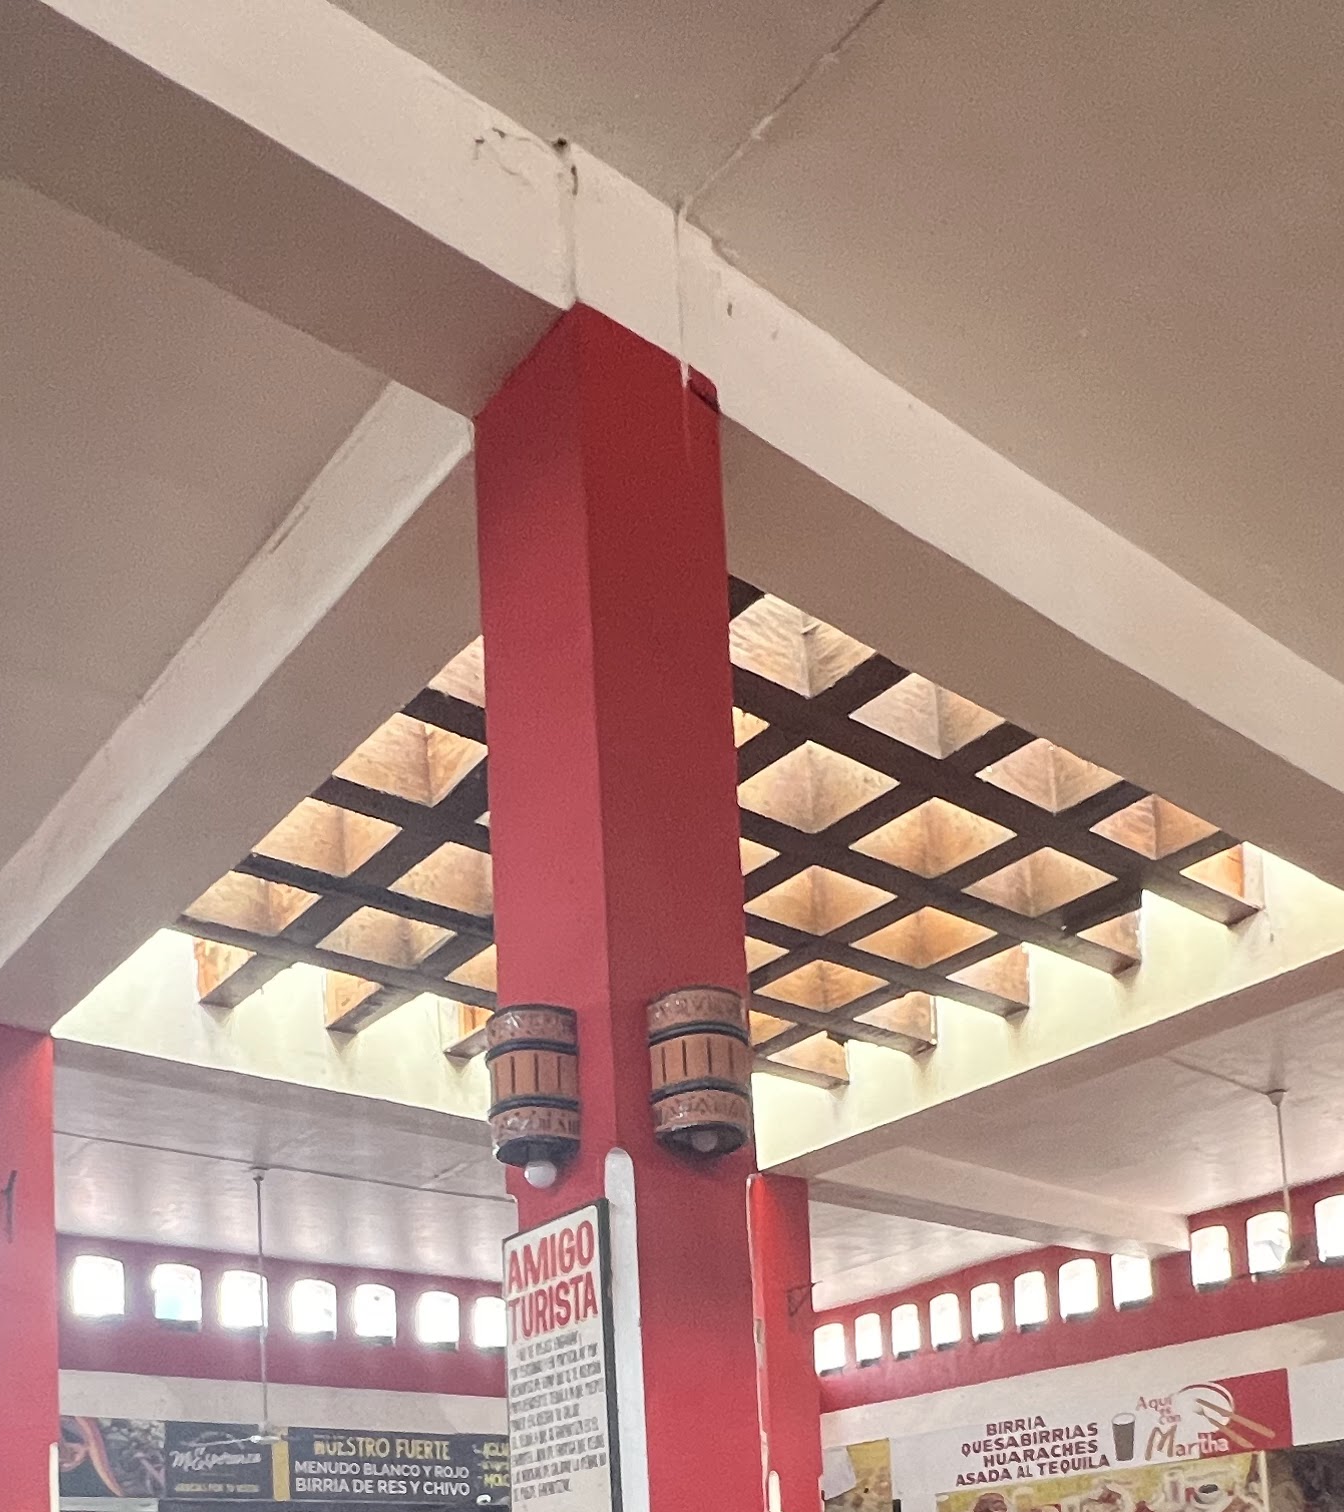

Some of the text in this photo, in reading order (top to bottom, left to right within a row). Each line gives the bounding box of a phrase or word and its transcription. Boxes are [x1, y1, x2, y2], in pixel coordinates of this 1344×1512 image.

[508, 1220, 595, 1294] AMIGO
[507, 1271, 599, 1344] TURISTA
[986, 1415, 1047, 1437] BIRRIA
[1159, 1414, 1181, 1425] con
[313, 1436, 391, 1459] NUESTRO
[395, 1438, 452, 1460] FUERTE
[961, 1422, 1099, 1458] QUESABIRRIAS
[983, 1439, 1099, 1468] HUARACHES
[1144, 1424, 1229, 1461] Martha
[294, 1460, 361, 1475] MENUDO
[363, 1462, 421, 1477] BLANCO
[423, 1465, 433, 1478] Y
[434, 1465, 471, 1479] ROJO
[955, 1454, 1111, 1488] ASADA AL TEQUILA
[295, 1477, 471, 1496] BIRRIA DE RES Y CHIVO
